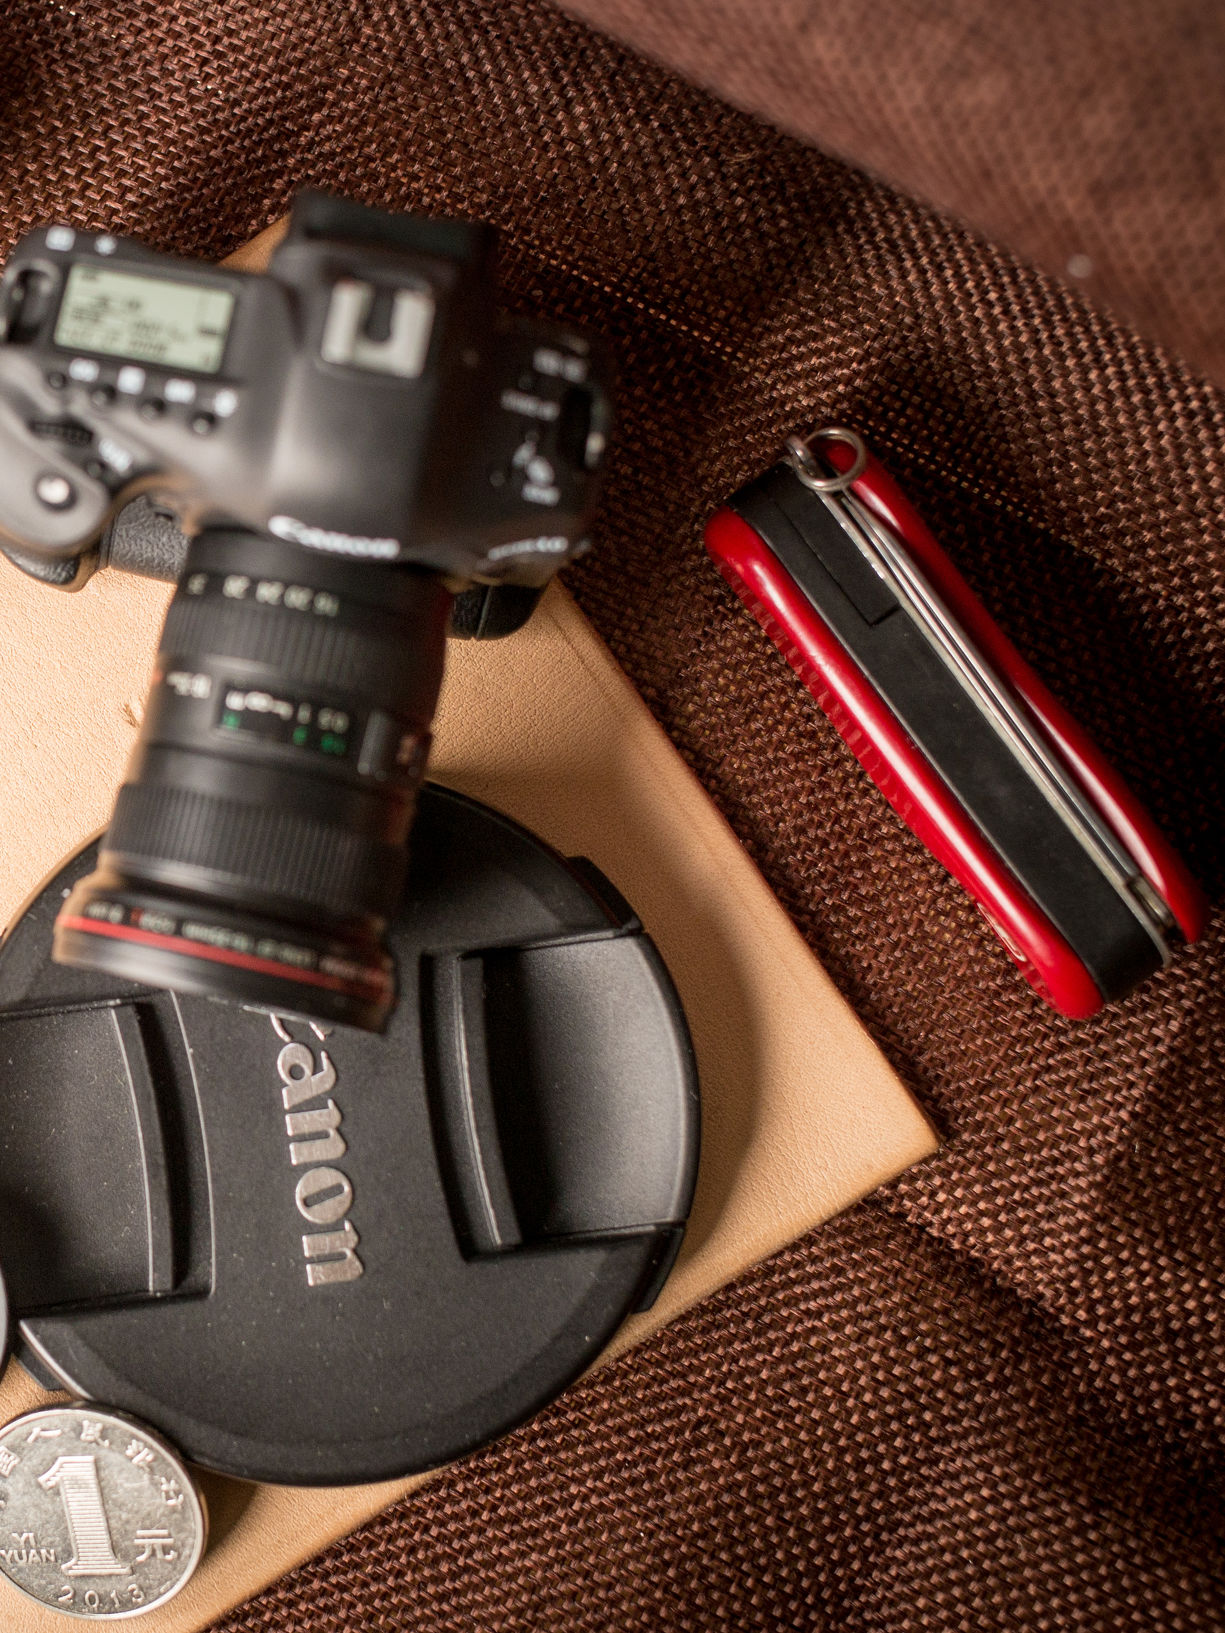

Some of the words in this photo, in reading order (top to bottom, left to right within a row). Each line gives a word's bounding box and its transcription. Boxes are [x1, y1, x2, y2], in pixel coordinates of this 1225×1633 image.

[270, 1012, 364, 1286] anon
[38, 1456, 132, 1576] 1
[134, 1530, 177, 1562] 元
[12, 1533, 37, 1547] YI
[0, 1550, 56, 1564] YUAN
[58, 1583, 145, 1609] 2013
